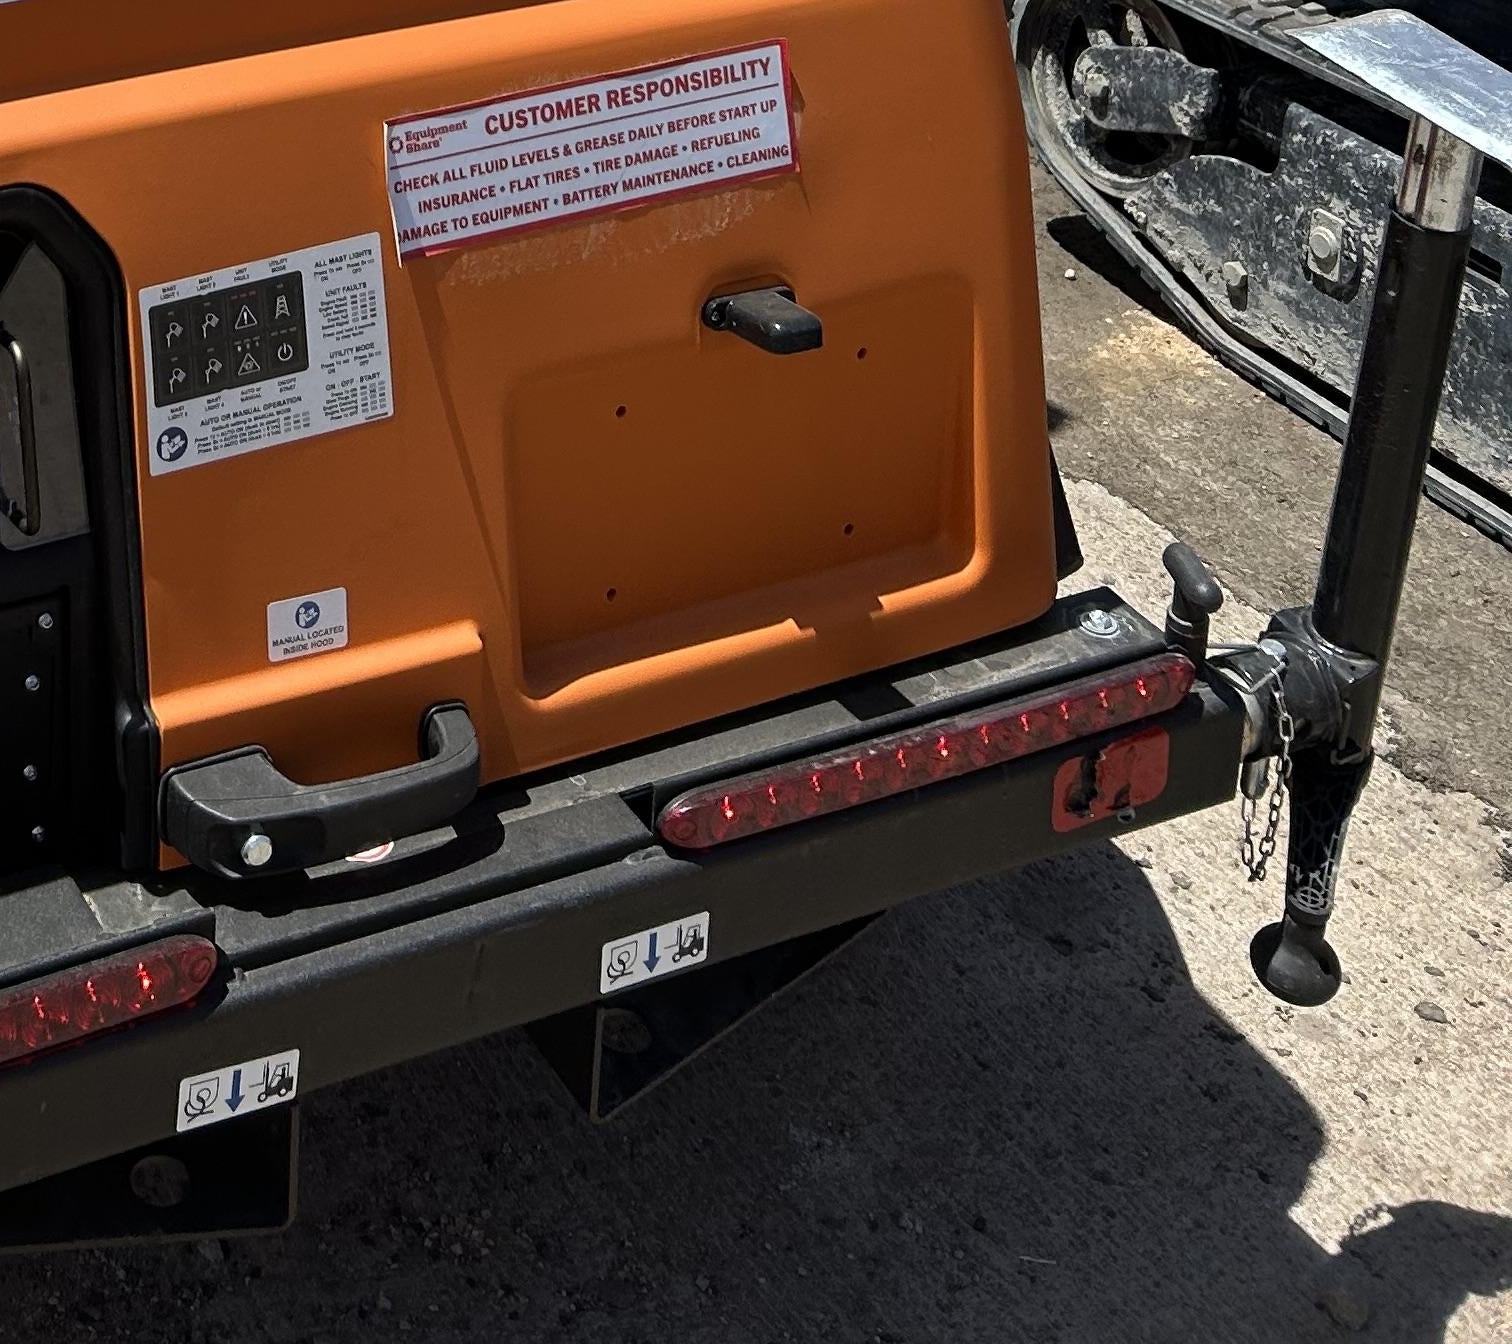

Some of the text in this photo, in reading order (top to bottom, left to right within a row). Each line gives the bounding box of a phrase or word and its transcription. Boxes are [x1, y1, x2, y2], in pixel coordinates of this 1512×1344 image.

[484, 56, 771, 136] CUSTOMER RESPONSIBILITY
[394, 98, 778, 194] CHECK ALL FLUID LEVELS & GREASE DAILY BEFORE START UP
[404, 119, 468, 143] Equipment
[405, 139, 441, 154] Share
[418, 126, 761, 214] INSURANCE FLAT TIRES TIRE DAMAGE REFUELING
[451, 216, 469, 232] TO
[472, 197, 549, 226] EQUIPMENT
[562, 181, 619, 207] BATTERY
[622, 160, 715, 193] MAINTENANCE
[726, 144, 789, 169] CLEANING
[272, 625, 345, 647] MANUAL LOCATED
[283, 637, 335, 656] INSIDE HOOD
